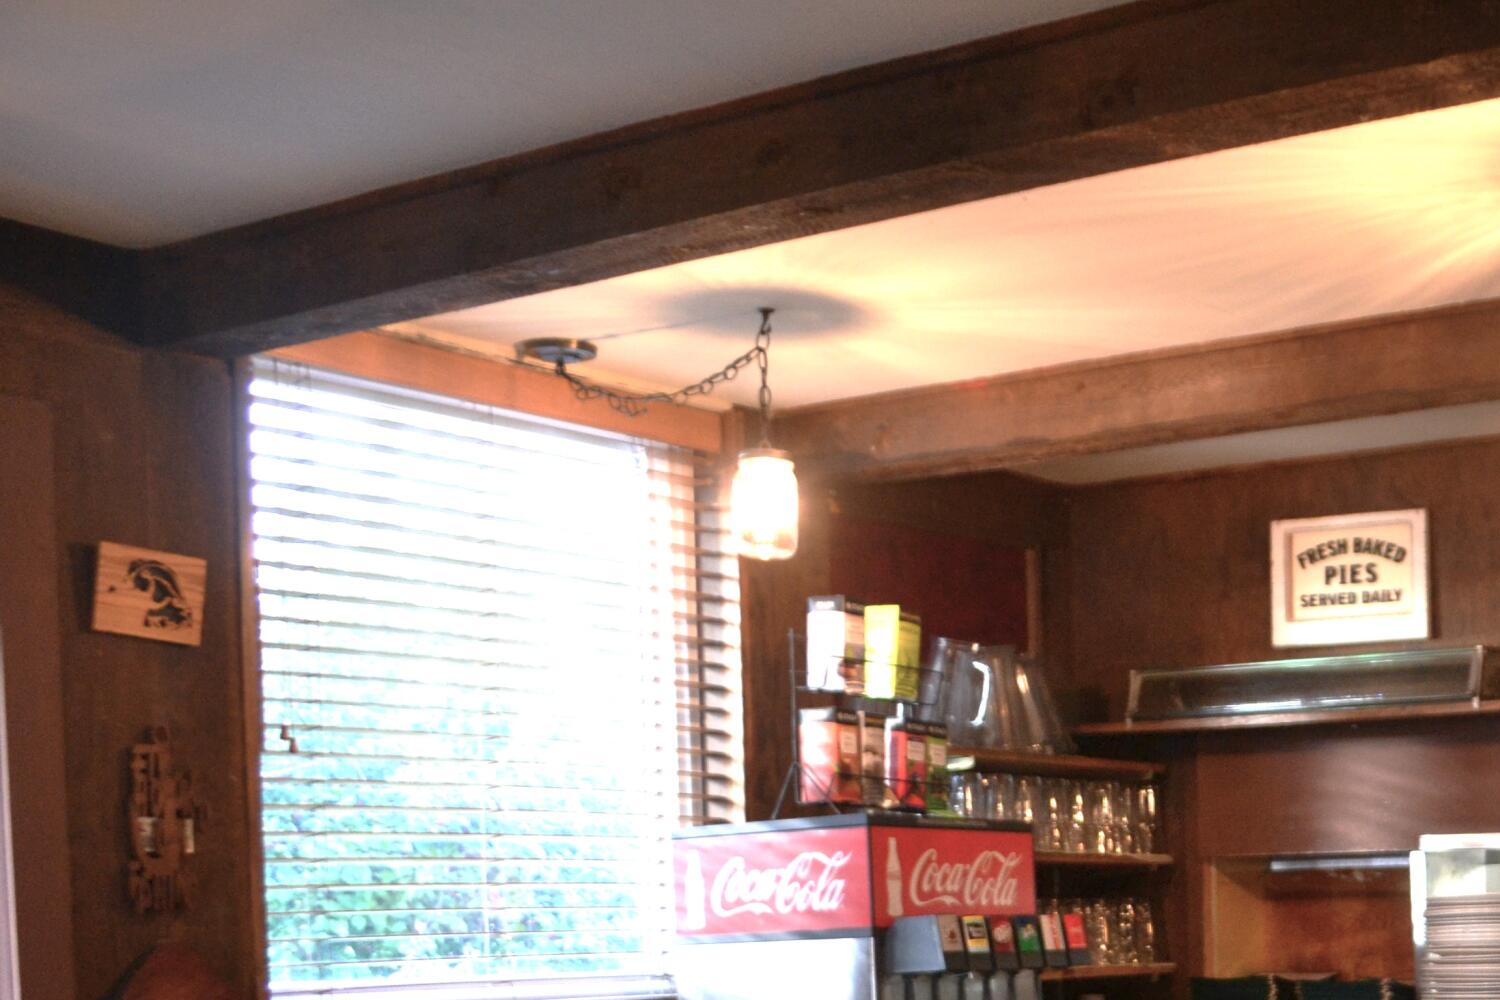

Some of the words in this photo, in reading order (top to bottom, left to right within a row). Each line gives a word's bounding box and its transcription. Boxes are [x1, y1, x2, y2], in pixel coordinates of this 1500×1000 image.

[1297, 538, 1349, 569] FRESH
[1353, 537, 1407, 563] BAKED
[1324, 563, 1378, 585] PIES
[1300, 591, 1357, 607] SERVED
[1361, 589, 1403, 603] DAILY
